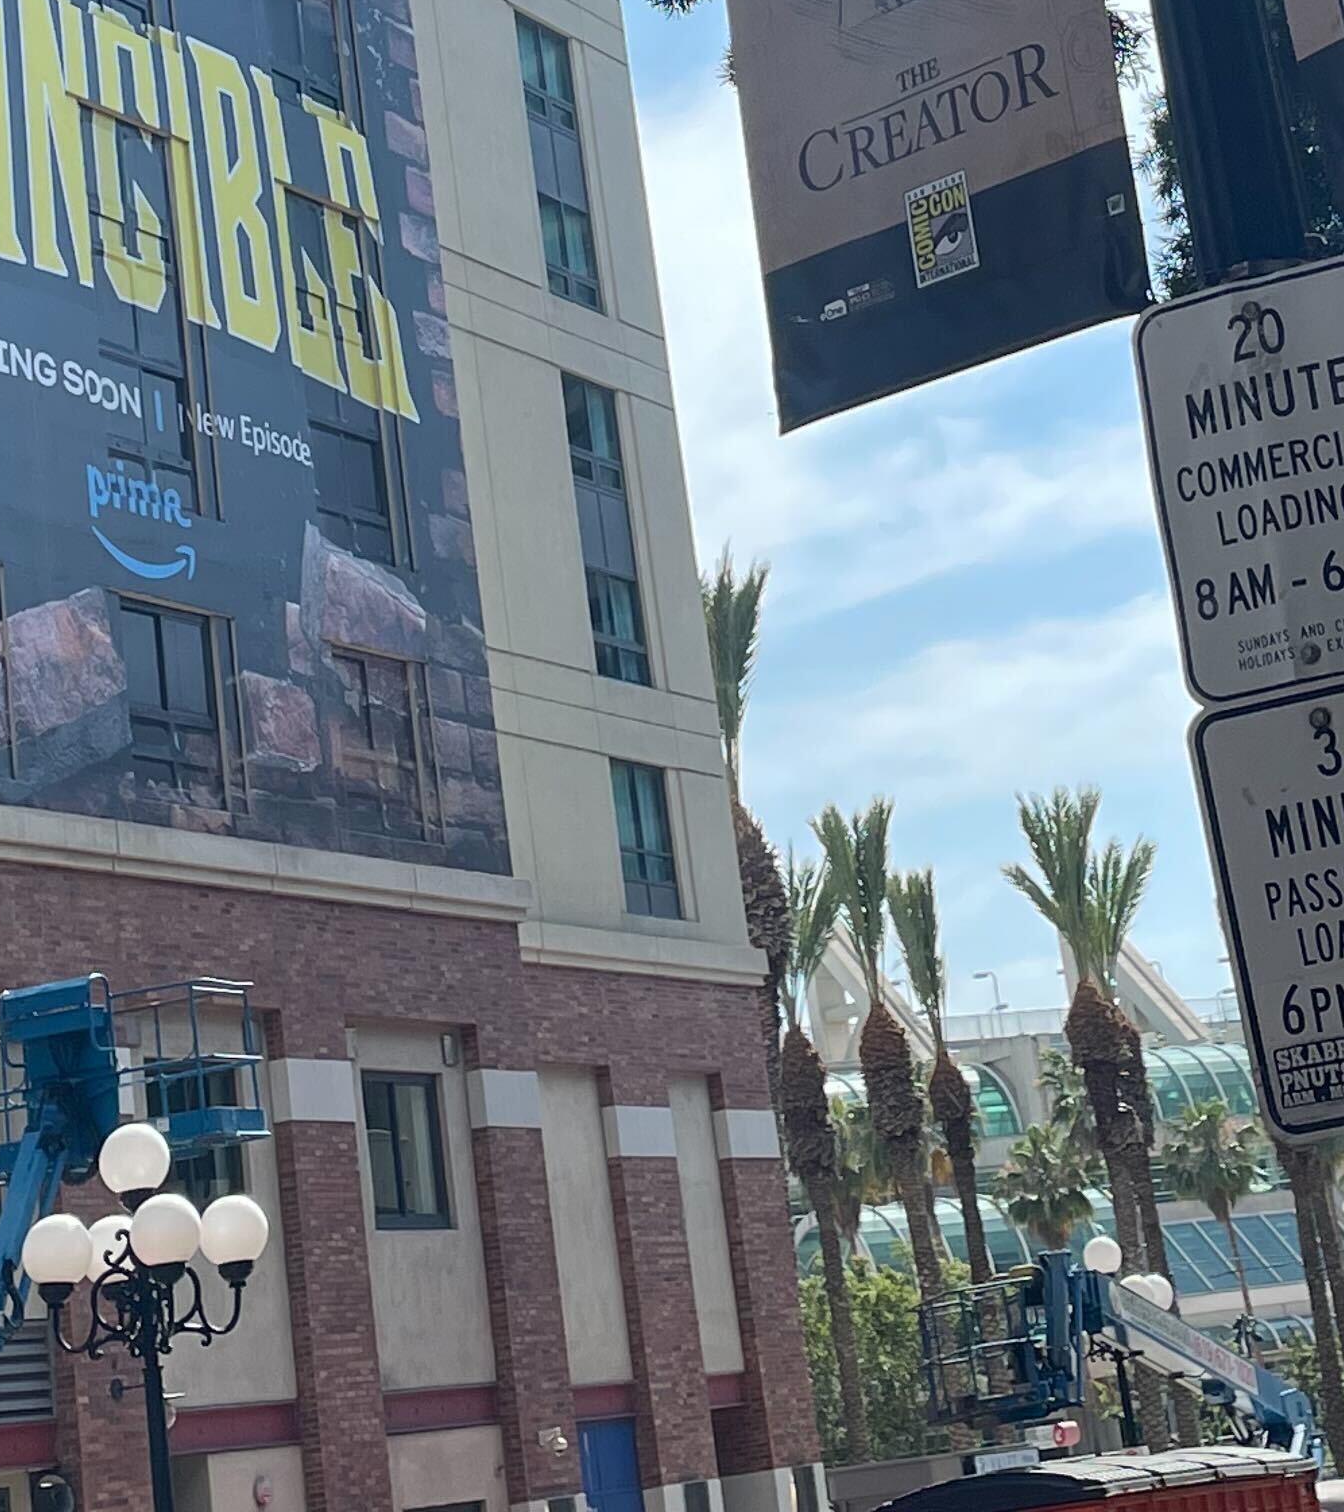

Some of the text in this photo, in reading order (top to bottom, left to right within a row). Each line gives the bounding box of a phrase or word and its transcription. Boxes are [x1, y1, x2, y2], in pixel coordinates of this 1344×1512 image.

[895, 57, 941, 93] THE
[797, 43, 1060, 193] CREATOR
[928, 183, 966, 217] CON
[910, 197, 937, 271] COMIC
[1226, 307, 1287, 364] 20
[62, 360, 143, 420] SOON
[178, 401, 236, 442] New
[85, 458, 193, 529] prime
[1237, 628, 1291, 655] SUNDAYS
[1300, 622, 1326, 639] AND
[1238, 646, 1297, 671] HOLIDAYS
[1313, 726, 1344, 778] 3
